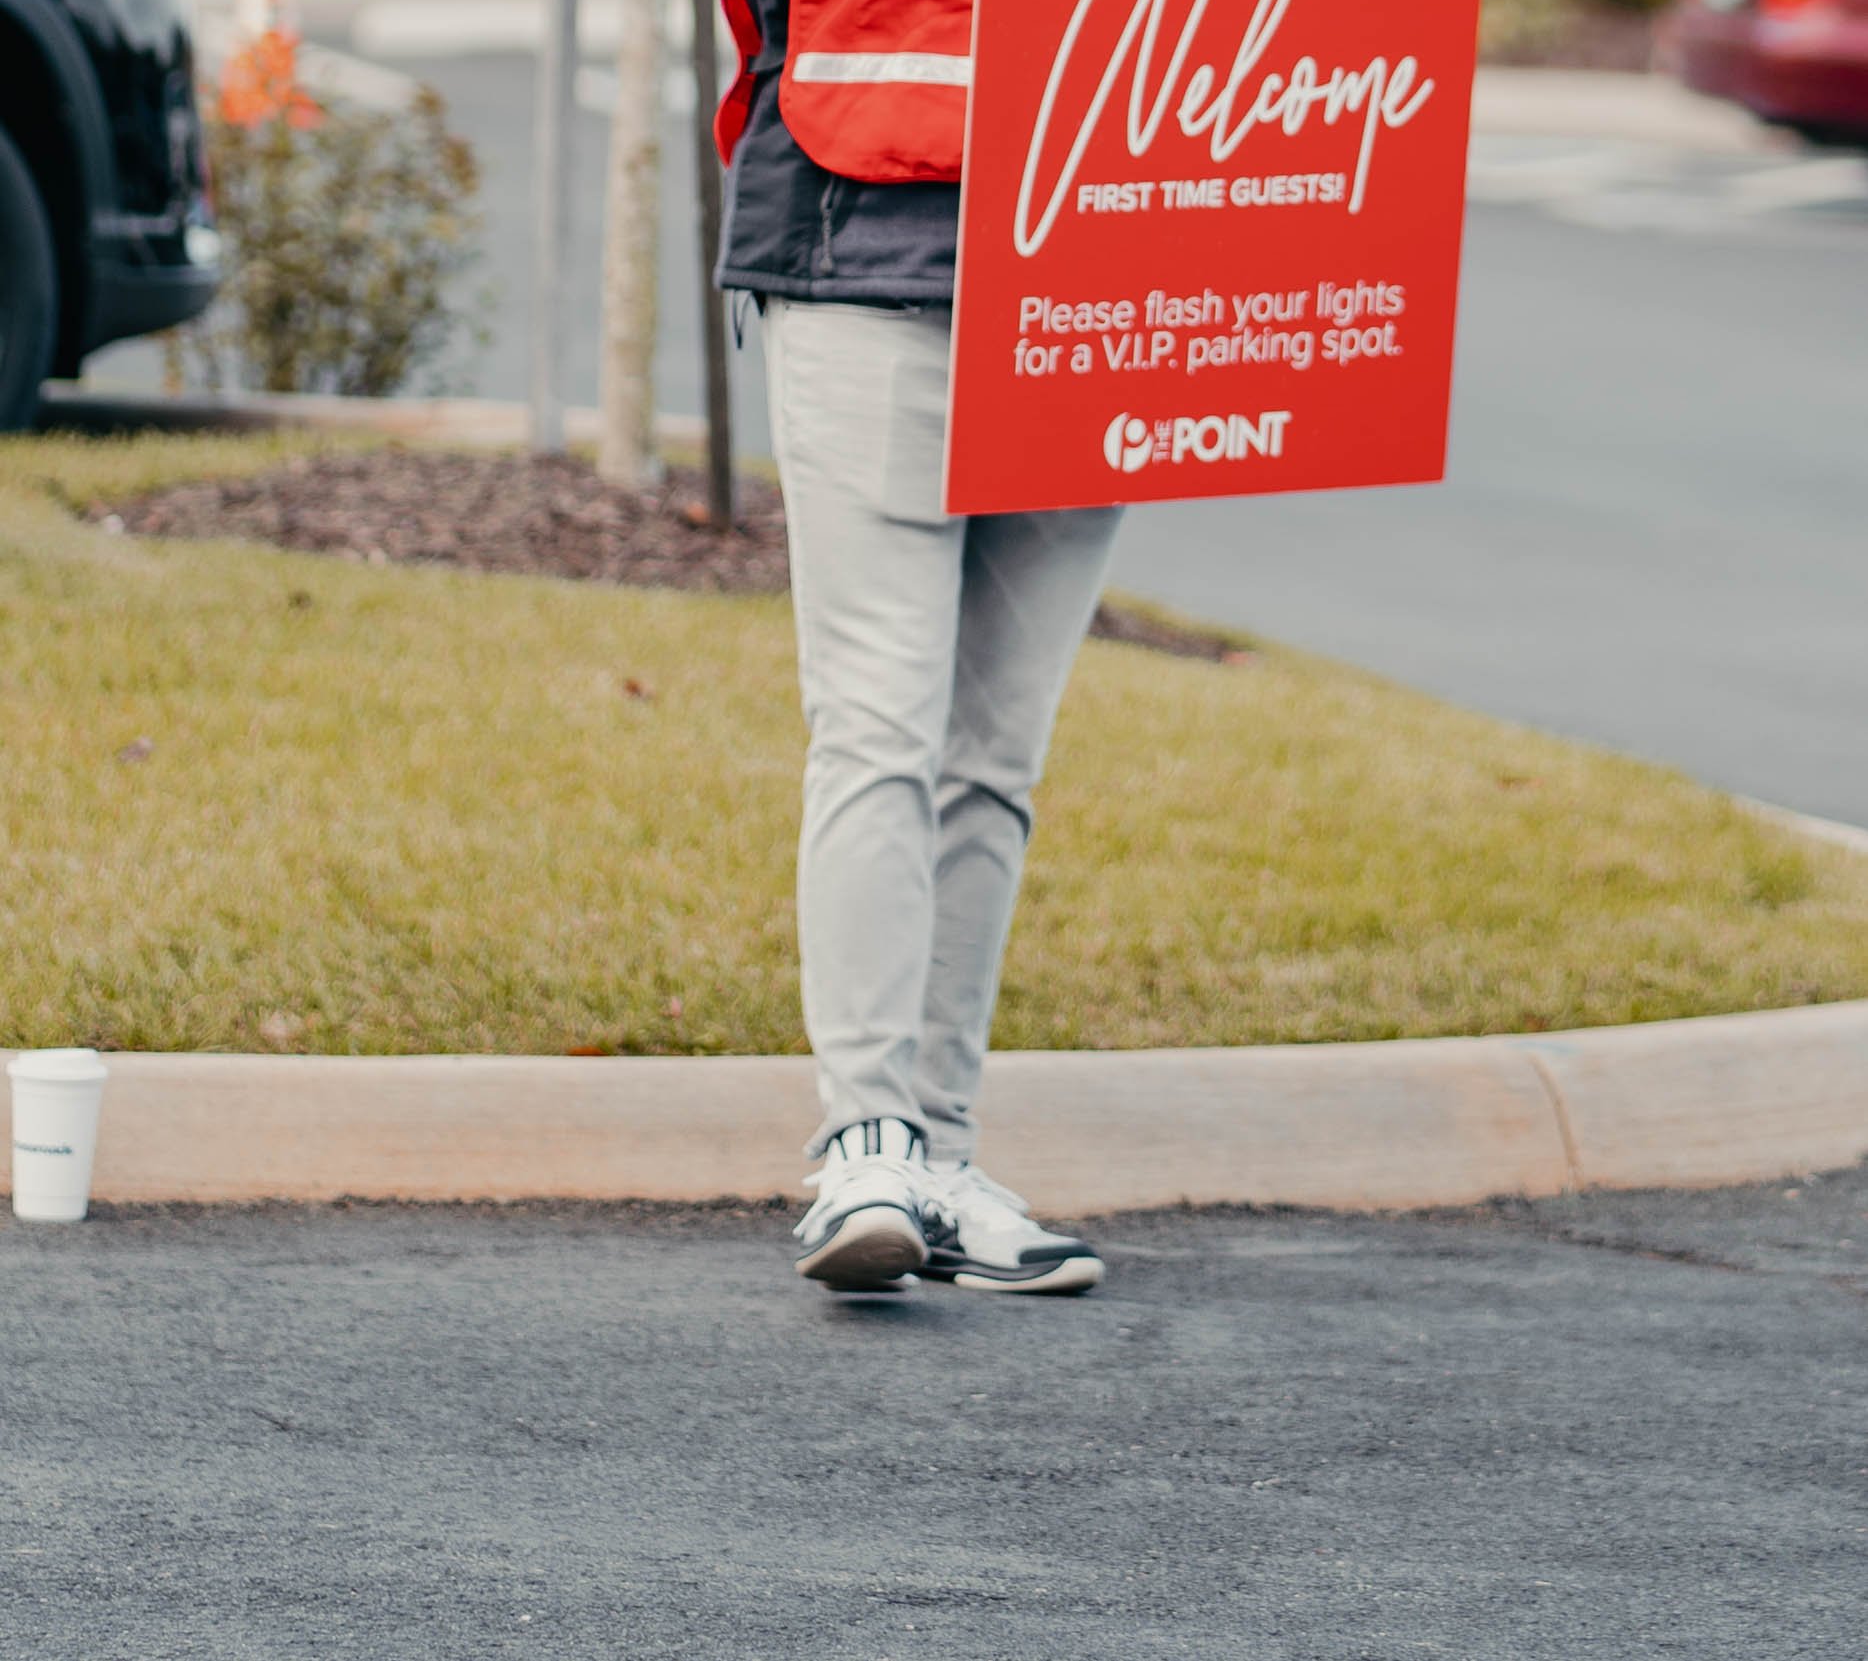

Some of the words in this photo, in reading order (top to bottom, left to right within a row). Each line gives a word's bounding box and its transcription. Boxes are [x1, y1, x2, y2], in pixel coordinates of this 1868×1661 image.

[1076, 181, 1156, 214] FIRST
[1159, 178, 1227, 210] TIME
[1229, 172, 1346, 207] GUESTS!
[1018, 296, 1137, 334] Please
[1144, 288, 1224, 328] flash
[1231, 290, 1309, 333] your
[1316, 280, 1405, 327] lights
[1013, 337, 1063, 376] for
[1070, 343, 1093, 374] a
[1101, 330, 1178, 371] V.I.P.
[1186, 326, 1315, 375] parking
[1321, 321, 1404, 368] spot.
[1152, 419, 1173, 465] THE
[1171, 410, 1292, 464] POINT
